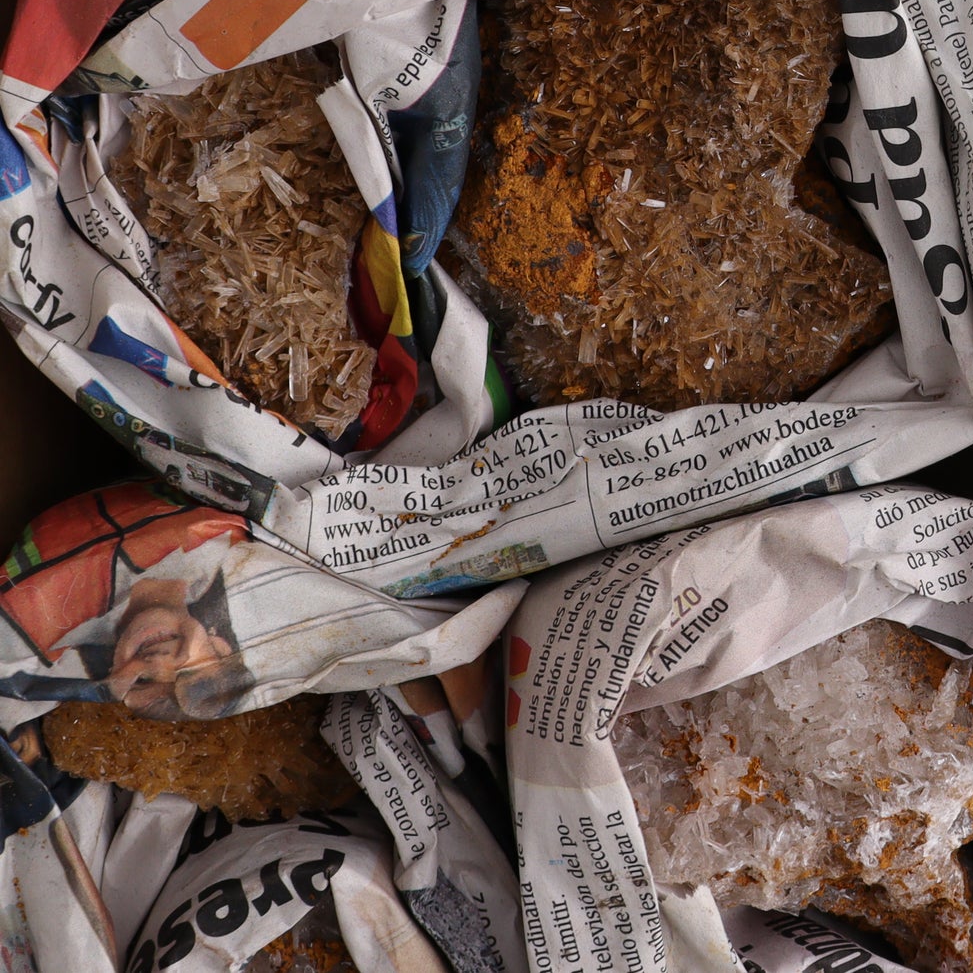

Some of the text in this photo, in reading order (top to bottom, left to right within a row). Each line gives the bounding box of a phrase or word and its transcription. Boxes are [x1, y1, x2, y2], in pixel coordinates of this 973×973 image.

[346, 456, 511, 490] #4501 tels. 614-
[480, 449, 569, 500] 126-8670
[513, 427, 560, 459] 421-
[606, 407, 866, 496] 126-8670 www.bodega-
[327, 491, 452, 514] 1080, 614-
[610, 437, 840, 526] automotrizchihuahua
[321, 529, 432, 570] chihuahua
[876, 507, 903, 528] dió
[908, 552, 926, 569] da
[938, 570, 967, 591] sus
[538, 592, 590, 739] dimisión. Todos
[659, 598, 728, 671] ATLÉTICO
[526, 607, 565, 735] Luis Rubiales
[554, 610, 596, 743] consecuentes
[570, 657, 600, 747] hacemos
[385, 787, 418, 841] zonas
[608, 811, 648, 887] sujetar la
[558, 816, 613, 971] televisión del po-
[579, 817, 633, 934] de selección
[552, 895, 580, 962] dimitir.
